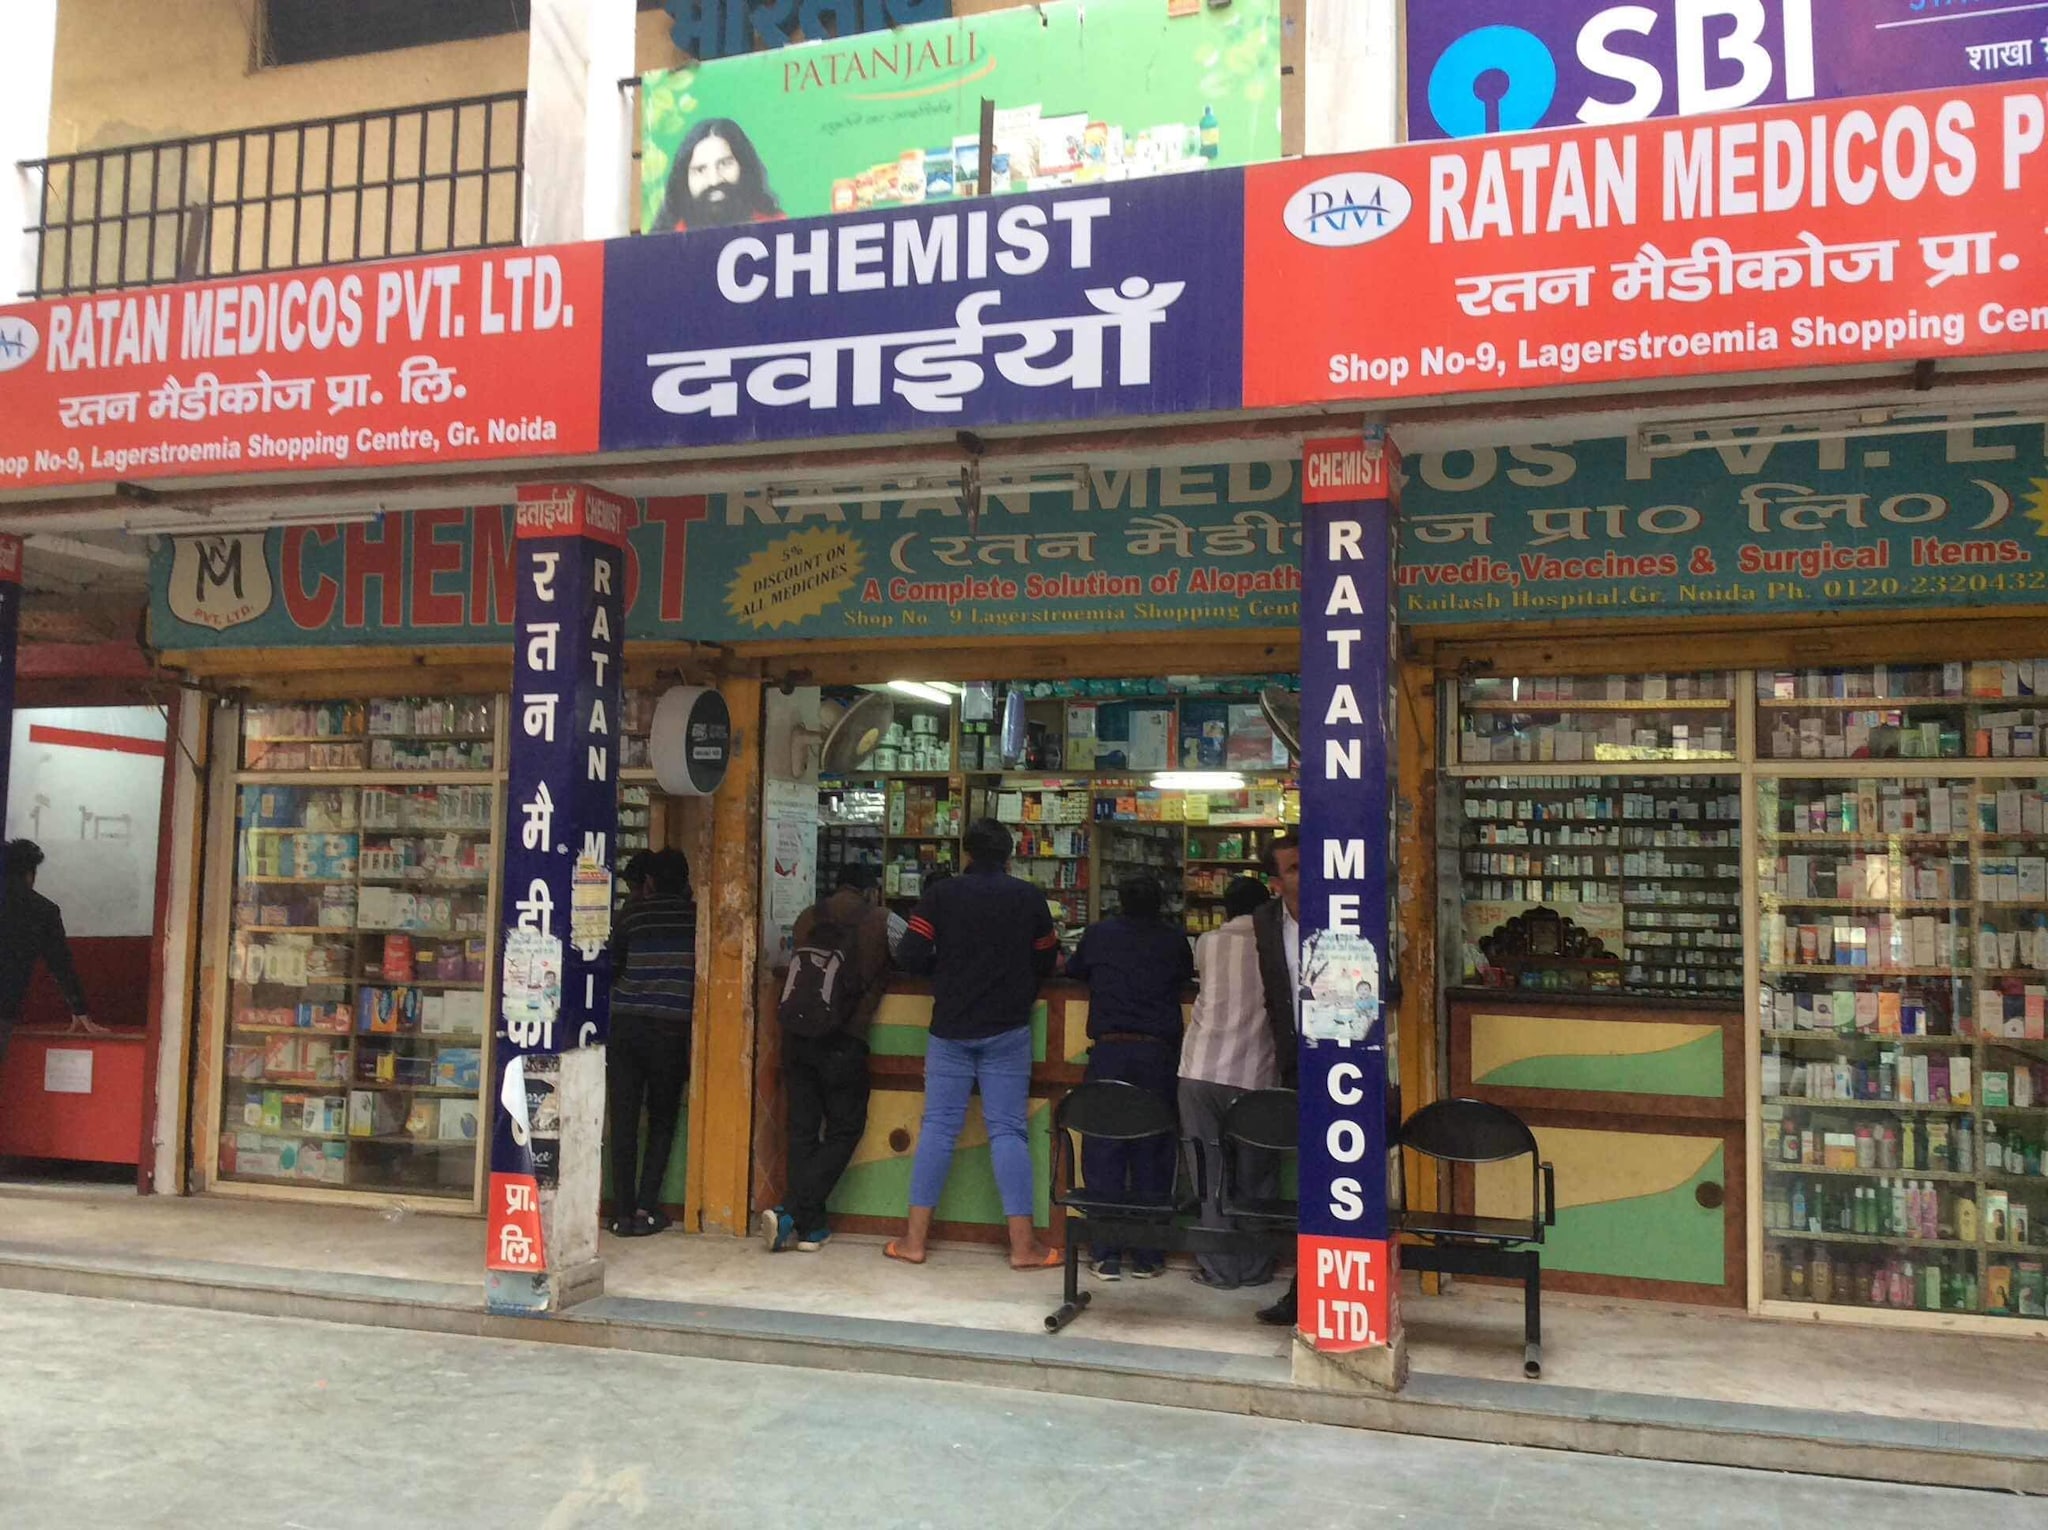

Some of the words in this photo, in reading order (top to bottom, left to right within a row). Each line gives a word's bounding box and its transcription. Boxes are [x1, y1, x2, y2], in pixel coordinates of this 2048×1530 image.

[783, 32, 977, 92] PATANJALI
[1575, 0, 1816, 125] SBI
[1965, 39, 2033, 71] शाखा
[1428, 133, 1637, 244] RATAN
[1663, 100, 1977, 221] MEDICOS
[2003, 93, 2048, 191] P
[716, 197, 1110, 303] CHEMIST
[1456, 266, 1595, 317] रतन
[1611, 231, 1896, 301] मैडीकोज
[1918, 232, 2020, 289] प्रा.
[46, 294, 171, 373] RATAN
[180, 274, 363, 359] MEDICOS
[376, 264, 465, 344] PVT.
[480, 254, 574, 335] LTD.
[647, 276, 1185, 417] दवाईयाँ
[1329, 354, 1410, 387] Shop
[1420, 342, 1507, 376] No-9,
[1518, 329, 1779, 370] Lagerstroemia
[1791, 309, 1966, 351] Shopping
[59, 391, 140, 429] रतन
[149, 370, 316, 422] मैडीकोज
[325, 373, 384, 416] प्रा.
[399, 354, 468, 405] लि.
[34, 447, 85, 473] No-9,
[91, 437, 242, 473] Lagerstroemia
[248, 431, 349, 462] Shopping
[356, 428, 440, 454] Centre,
[447, 422, 481, 446] Gr.
[487, 416, 557, 443] Noida
[1072, 443, 1578, 511] MEDOS
[1307, 452, 1383, 489] CHEMIST
[281, 495, 708, 630] CHEMT
[742, 598, 764, 618] ALL
[771, 562, 849, 605] MEDICINES
[752, 553, 822, 594] DISCOUNT
[826, 543, 847, 562] ON
[861, 577, 882, 603] A
[888, 574, 1018, 606] Complete
[1023, 569, 1143, 600] Solution
[1149, 566, 1182, 596] of
[1188, 562, 1302, 598] Alopath
[1688, 545, 1717, 575] &
[1738, 538, 1890, 579] Surgical
[1912, 536, 2031, 567] Items.
[844, 608, 894, 629] Shop
[949, 609, 964, 625] 9
[971, 604, 1127, 627] Lagerstroemia
[1133, 600, 1240, 623] Shopping
[1247, 599, 1301, 618] Cent
[1407, 590, 1501, 611] Kailash
[1679, 582, 1757, 604] Noida
[587, 558, 613, 783] RATAN
[1324, 521, 1364, 780] RATAN
[1323, 838, 1366, 1222] MECOS
[505, 1184, 536, 1215] प्रा.
[500, 1224, 537, 1265] लि.
[1317, 1248, 1375, 1292] PVT.
[1316, 1299, 1377, 1344] LTD.
